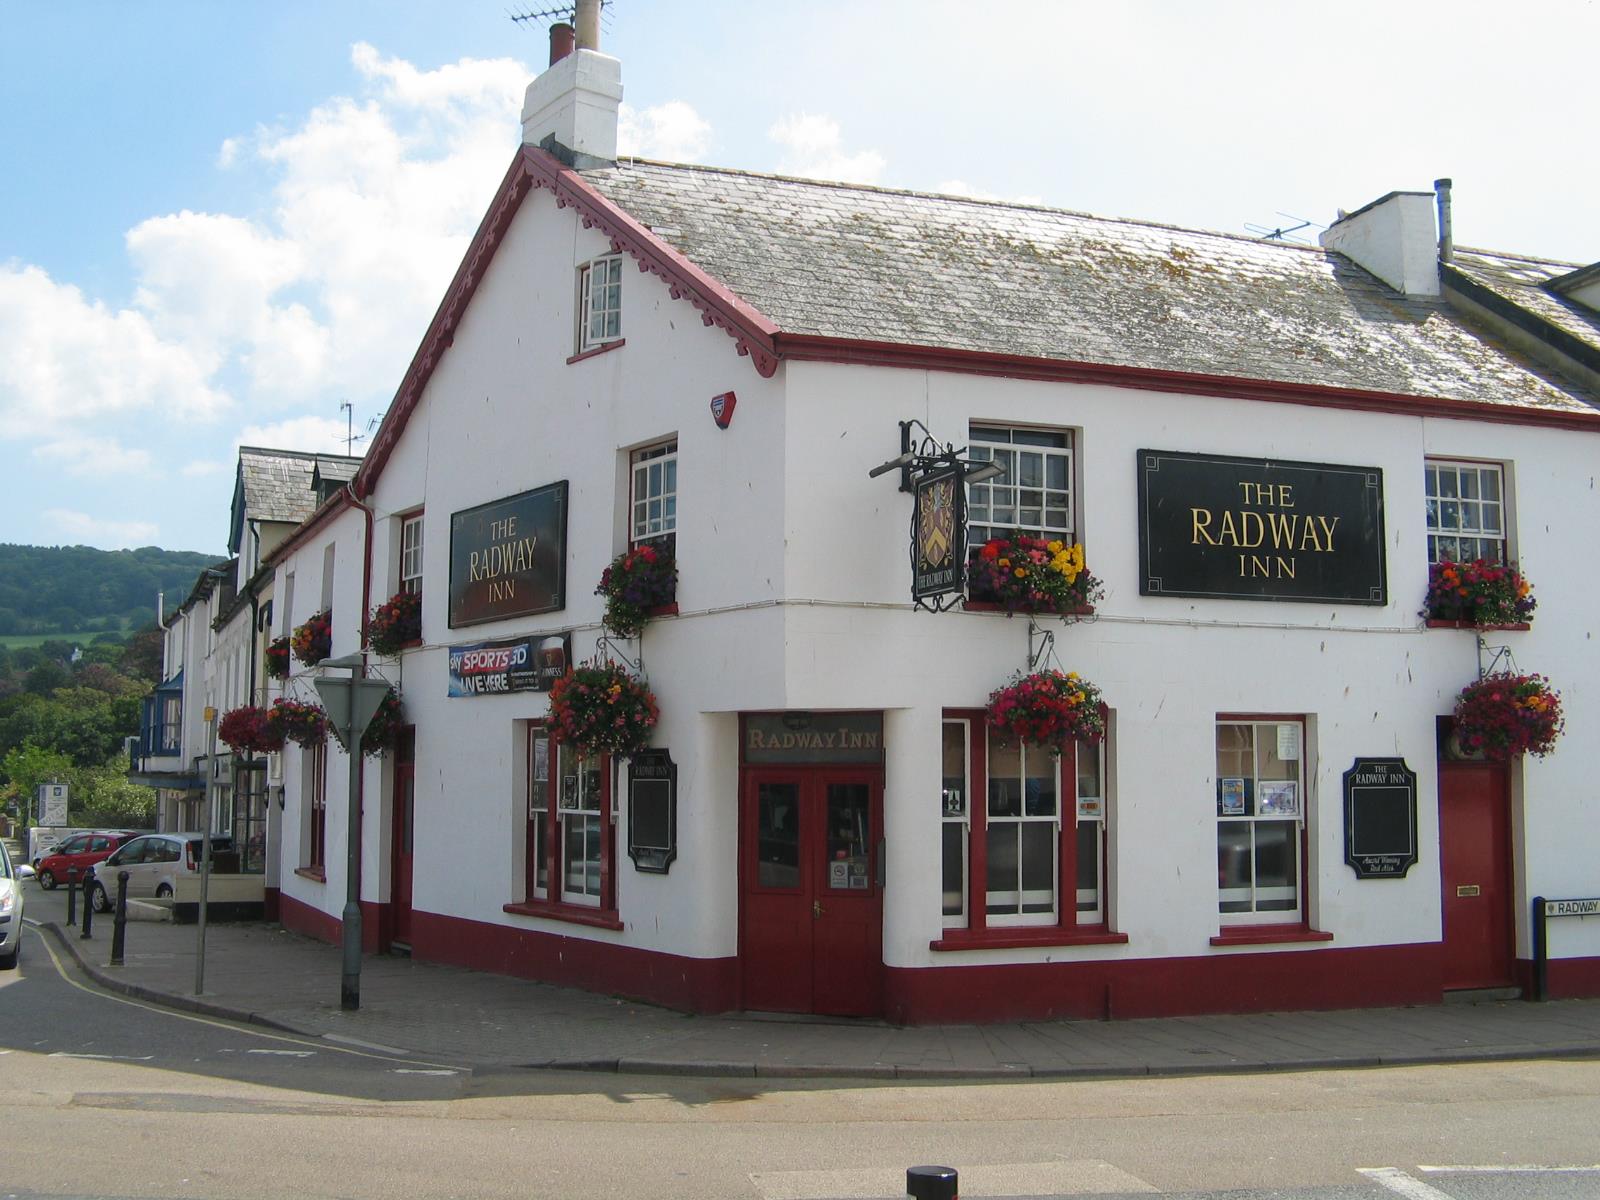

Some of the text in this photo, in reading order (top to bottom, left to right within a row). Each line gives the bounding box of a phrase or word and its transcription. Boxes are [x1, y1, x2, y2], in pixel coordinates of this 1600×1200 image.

[1239, 482, 1296, 508] THE
[490, 517, 517, 540] THE
[1190, 507, 1340, 552] RADWAY
[469, 537, 537, 583] RADWAY
[1239, 555, 1296, 579] INN
[488, 580, 515, 603] INN
[463, 650, 509, 670] SPORTS
[510, 647, 527, 665] 3D
[460, 675, 483, 692] LIVE
[483, 673, 509, 691] HERE
[540, 667, 562, 678] INNESS
[1356, 773, 1405, 784] RADWAY INN
[1558, 902, 1597, 913] RADWAY
